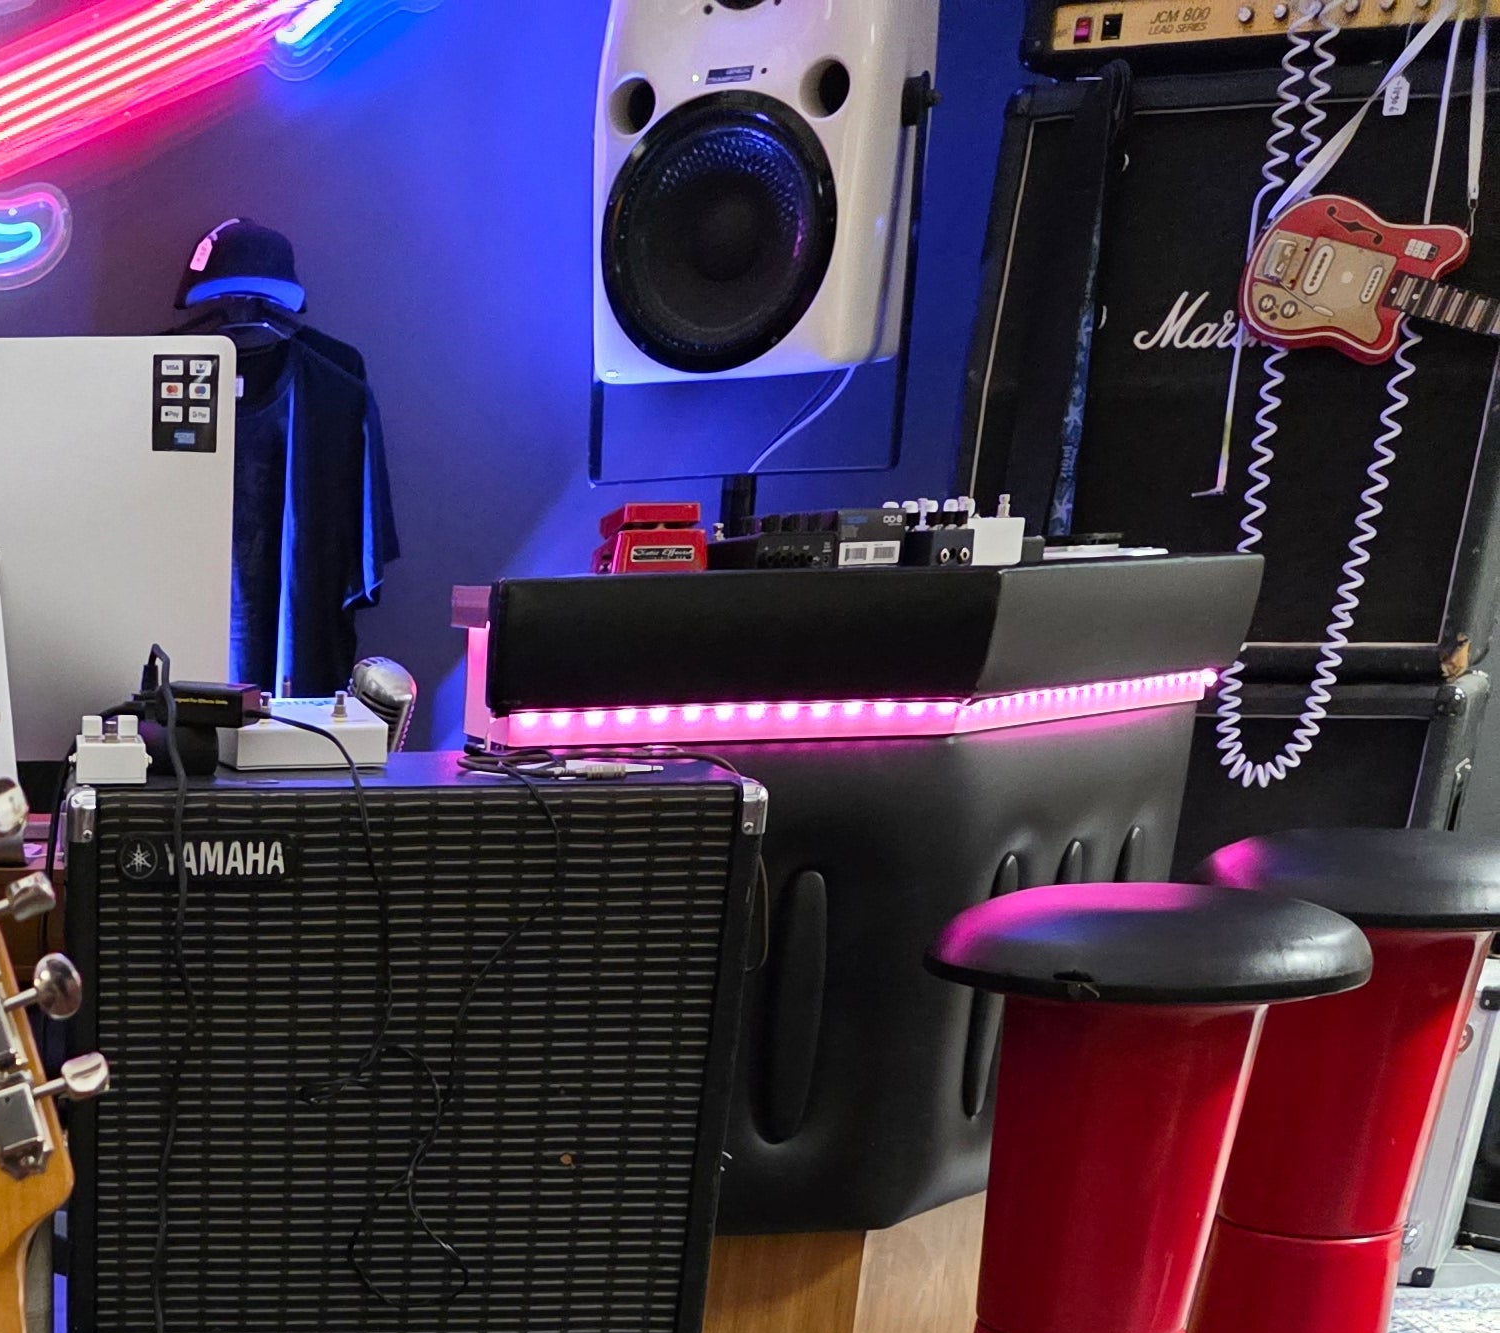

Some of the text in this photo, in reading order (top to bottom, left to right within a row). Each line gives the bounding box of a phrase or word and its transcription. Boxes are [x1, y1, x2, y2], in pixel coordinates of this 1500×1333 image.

[1149, 6, 1212, 25] JCM 800
[1147, 22, 1208, 36] LEAD SERIES
[164, 841, 286, 876] YAMAHA
